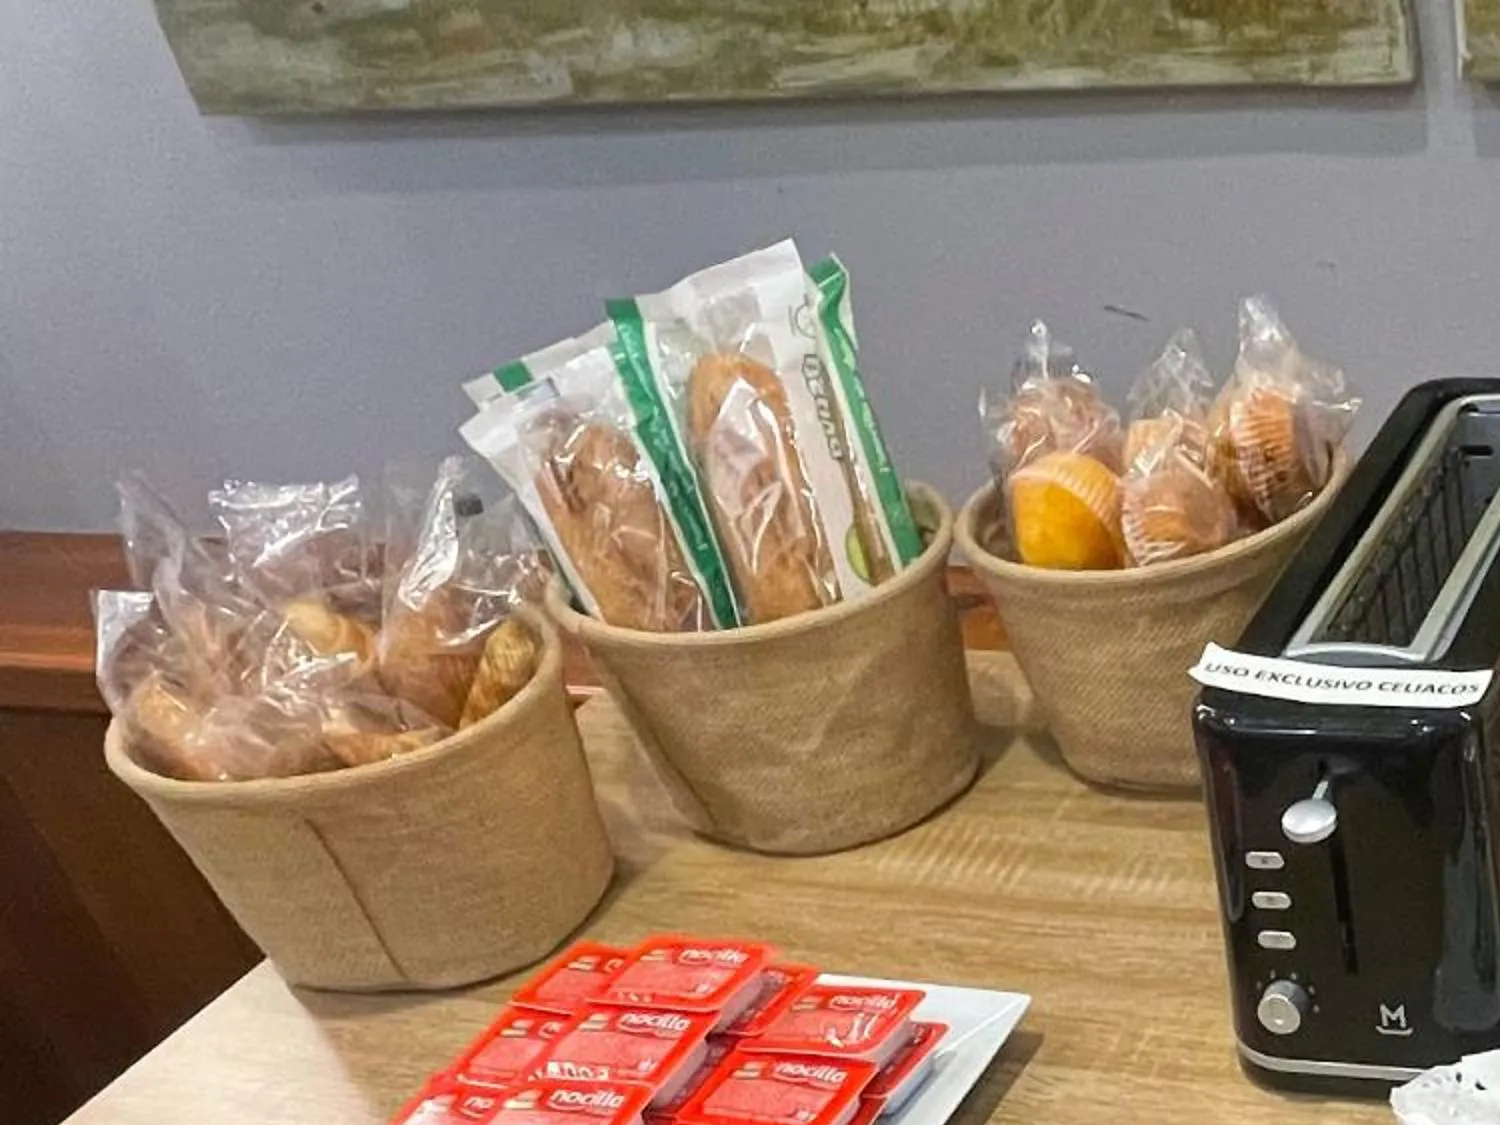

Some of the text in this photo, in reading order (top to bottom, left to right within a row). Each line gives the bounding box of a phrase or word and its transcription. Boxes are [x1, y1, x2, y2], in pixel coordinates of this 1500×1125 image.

[1204, 662, 1479, 695] USO EXCLUSIVO CELIACOS
[621, 1012, 691, 1031] nocilla
[774, 1061, 848, 1083] nocilla
[549, 1089, 625, 1110] nocilla
